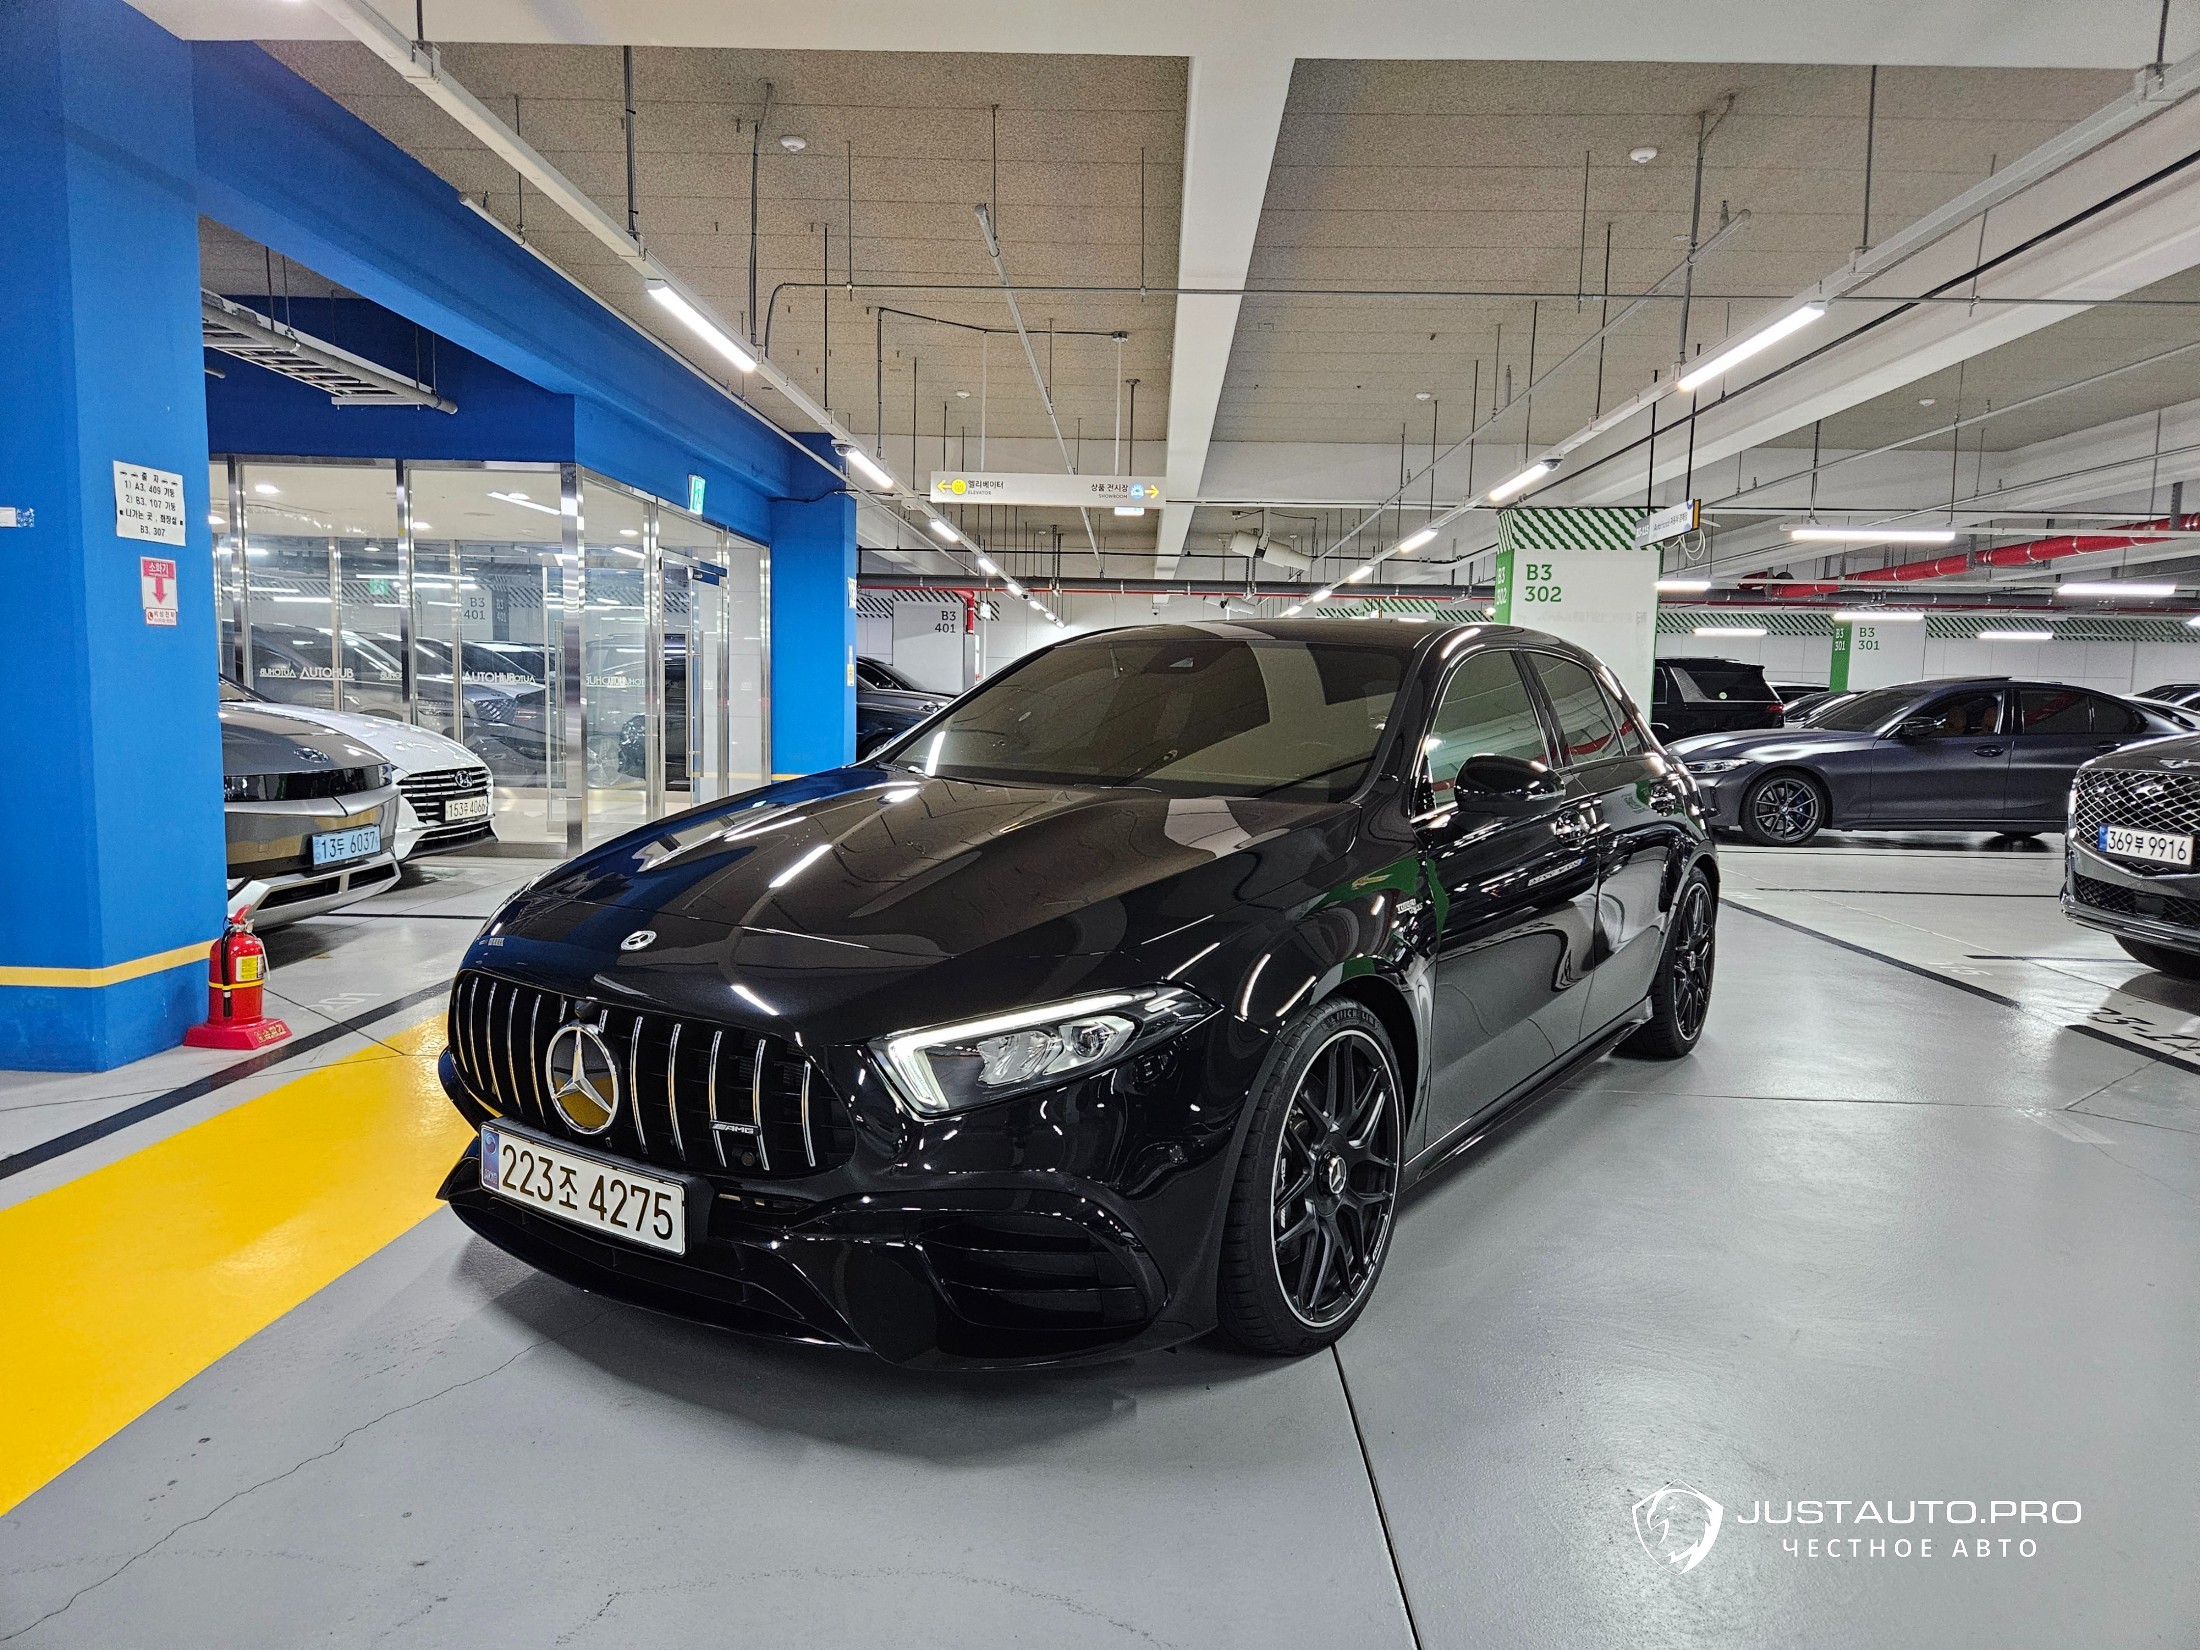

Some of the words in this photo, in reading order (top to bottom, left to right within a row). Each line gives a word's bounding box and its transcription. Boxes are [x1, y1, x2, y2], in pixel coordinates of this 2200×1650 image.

[1091, 483, 1105, 492] 상품
[1107, 483, 1128, 492] 전시장
[149, 499, 162, 509] 107
[126, 508, 144, 520] 나가는
[160, 514, 177, 526] 화장실
[153, 527, 166, 537] 307
[149, 562, 169, 575] 소화기
[1526, 564, 1553, 581] B3
[1524, 586, 1562, 603] 302
[469, 597, 485, 608] B3
[463, 610, 485, 620] 401
[941, 610, 957, 621] B3
[934, 623, 956, 634] 401
[1835, 628, 1844, 639] B3
[1859, 627, 1875, 638] B3
[1834, 640, 1846, 651] 301
[1858, 640, 1880, 650] 301
[300, 667, 355, 680] AUTOHUB
[321, 838, 345, 860] 13두
[350, 831, 375, 853] 6037
[2108, 830, 2144, 853] 369부
[2149, 836, 2187, 860] 9916
[502, 1144, 578, 1210] 223조
[588, 1175, 673, 1240] 4275
